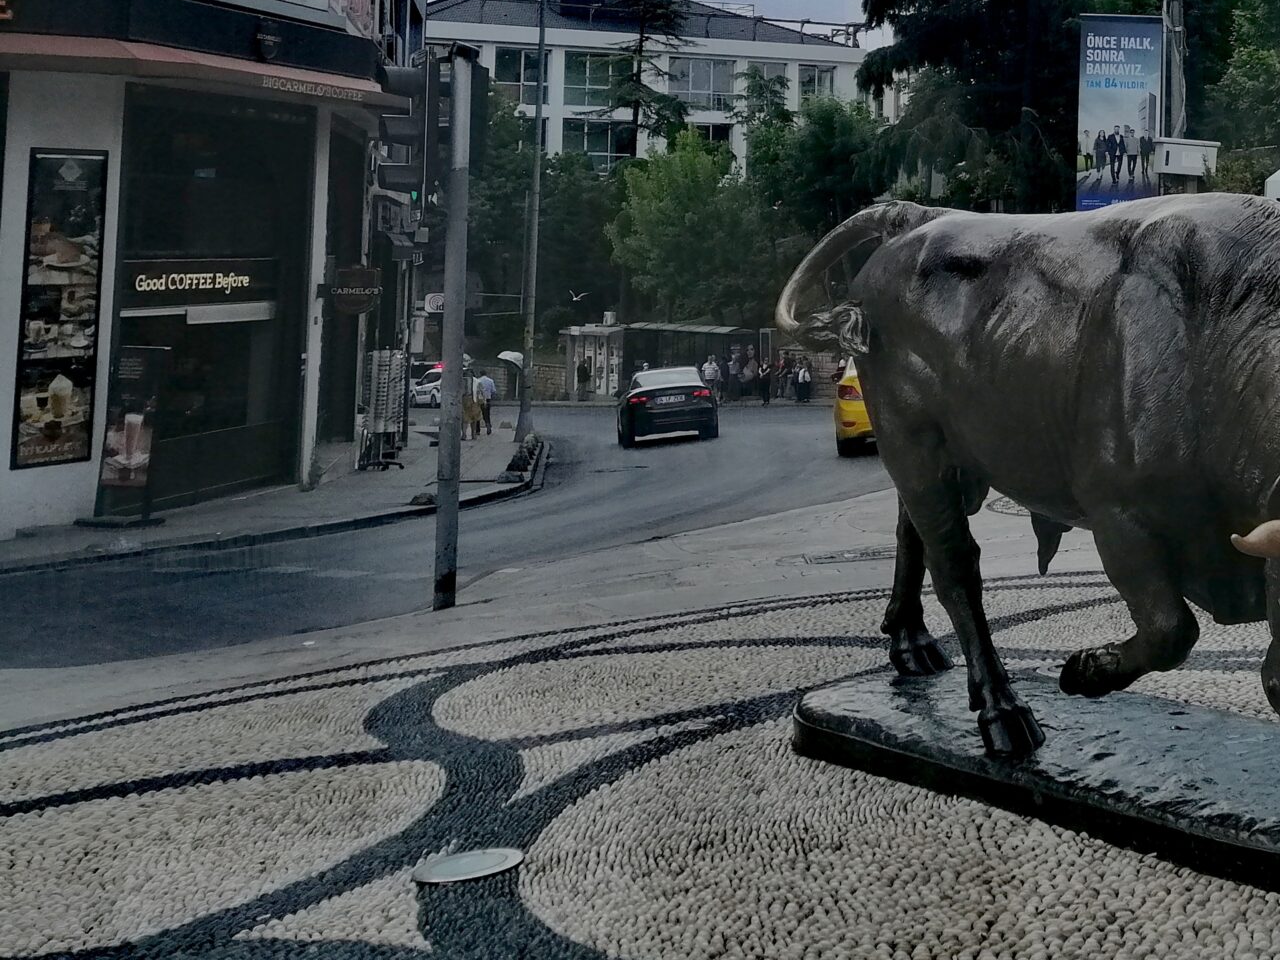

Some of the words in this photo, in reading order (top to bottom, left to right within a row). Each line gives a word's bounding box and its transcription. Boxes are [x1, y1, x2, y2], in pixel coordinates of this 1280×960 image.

[1086, 32, 1118, 49] ÖNCE
[1120, 36, 1154, 51] HALK,
[1086, 49, 1125, 62] SONRA
[1086, 63, 1145, 76] BANKAYIZ.
[1104, 77, 1118, 88] 84
[135, 274, 166, 291] Good
[168, 273, 214, 290] COFFEE
[214, 272, 250, 294] Before
